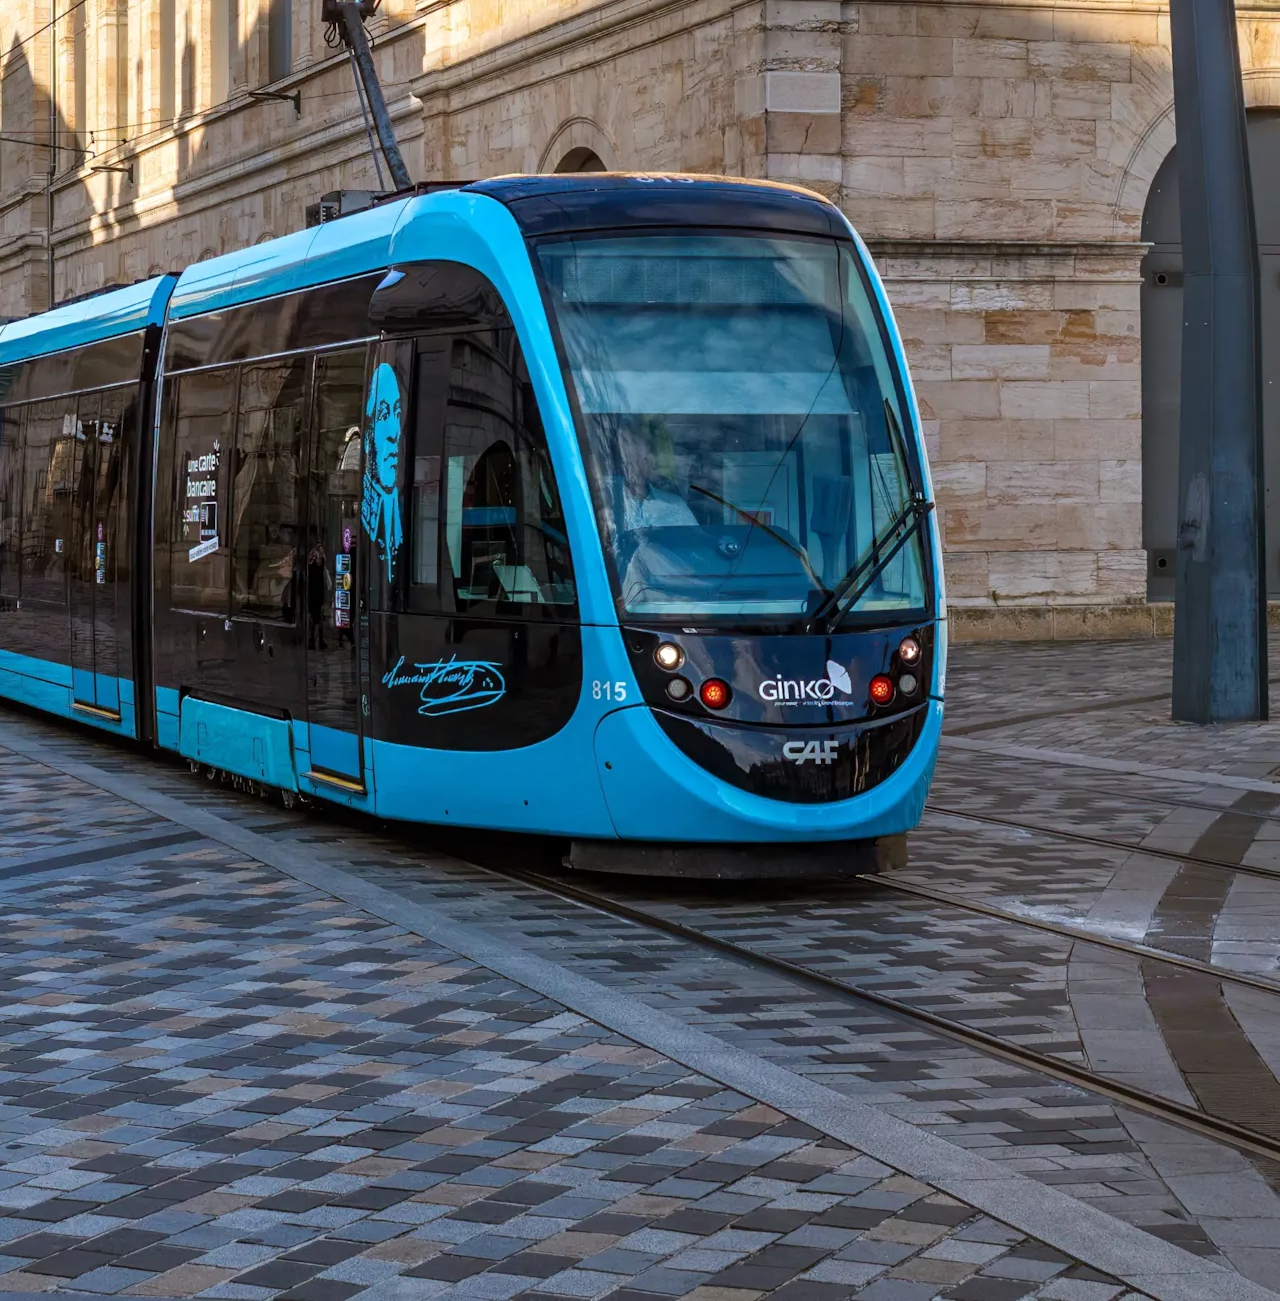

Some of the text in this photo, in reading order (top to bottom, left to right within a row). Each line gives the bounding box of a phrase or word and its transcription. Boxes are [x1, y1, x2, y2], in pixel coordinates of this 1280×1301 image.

[187, 475, 215, 497] bancaire
[592, 680, 627, 702] 815
[782, 740, 839, 765] CAF
